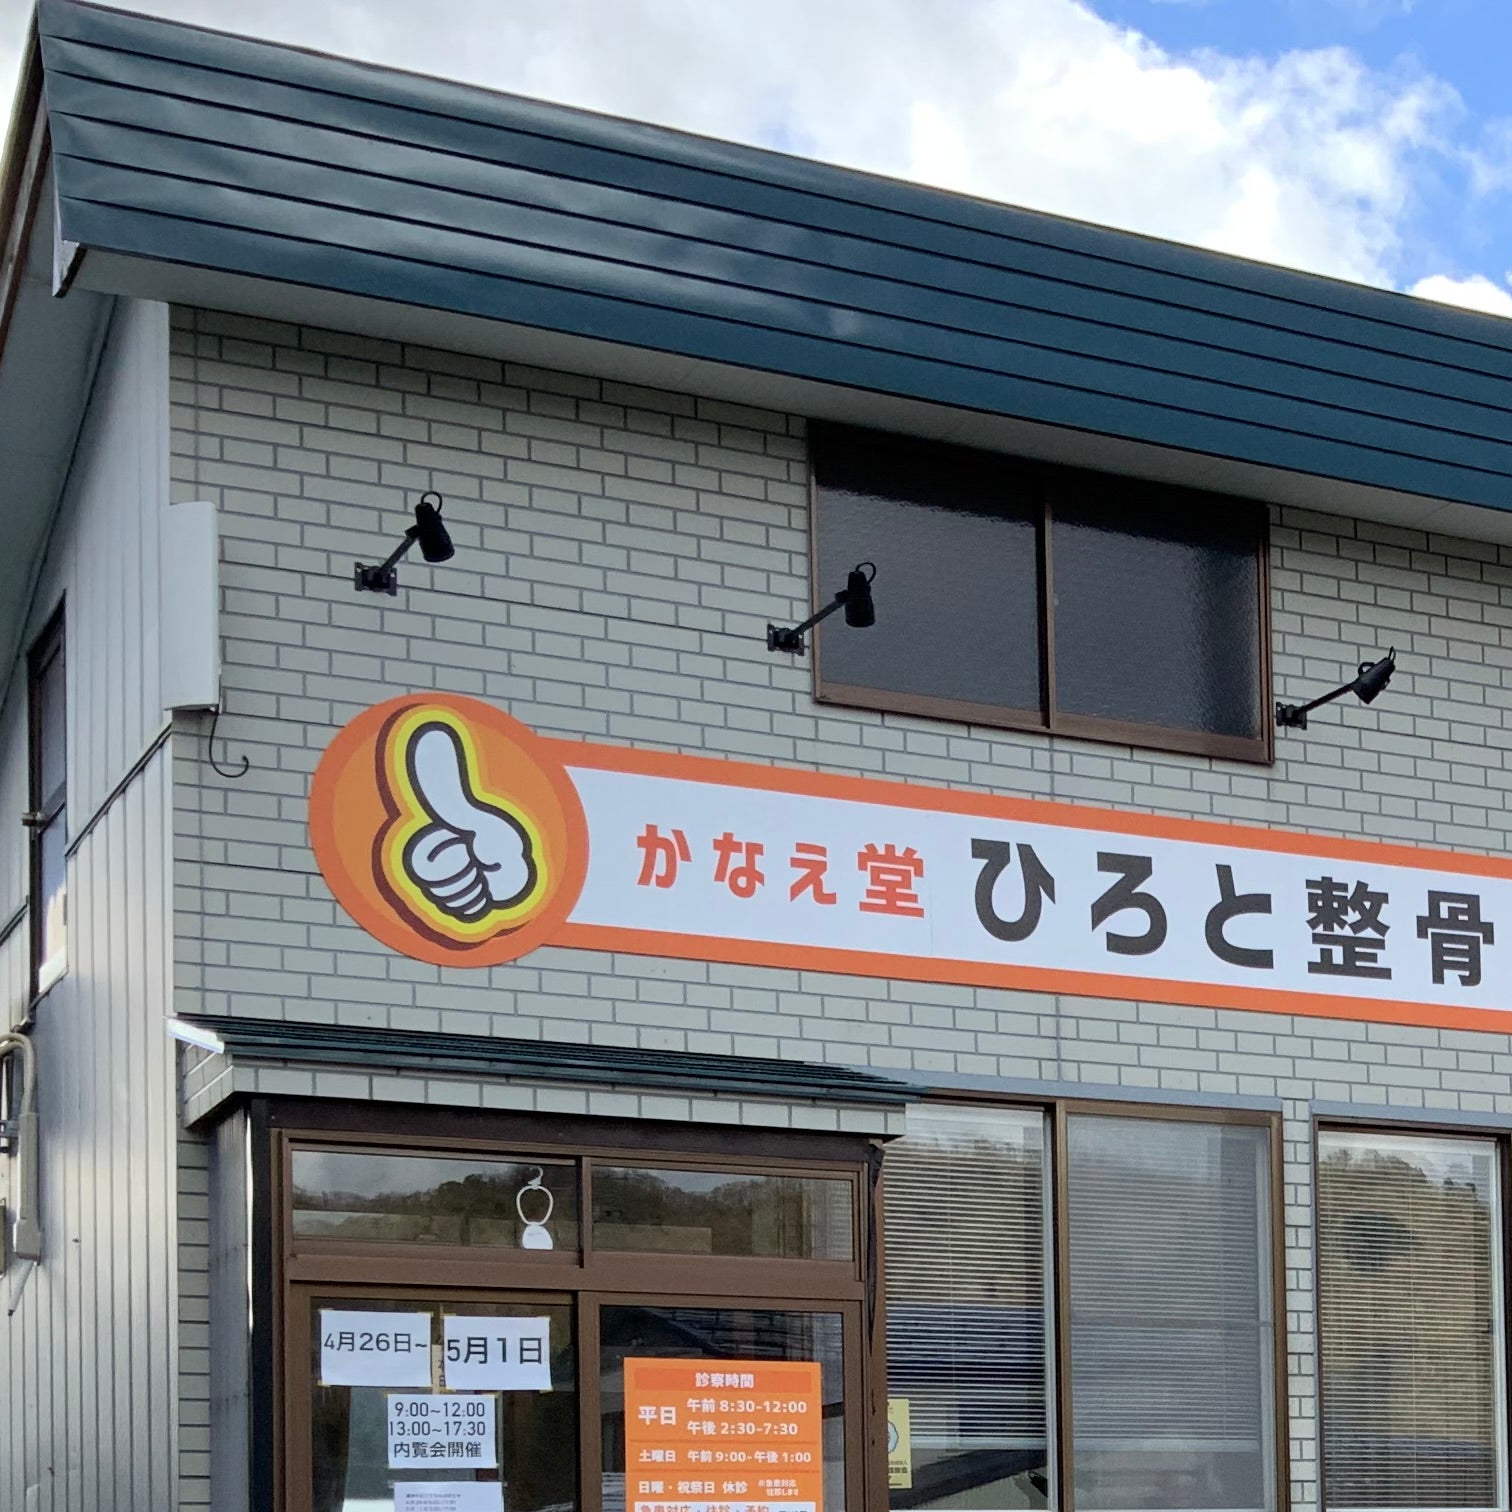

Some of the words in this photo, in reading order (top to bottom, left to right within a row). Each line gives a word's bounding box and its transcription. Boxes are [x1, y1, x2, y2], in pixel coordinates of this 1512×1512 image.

[636, 822, 925, 919] かなえ堂
[446, 1336, 543, 1365] 5月1日
[695, 1372, 755, 1389] 診察時間
[394, 1401, 485, 1418] 9:00~12:00
[686, 1398, 716, 1414] 午前
[719, 1400, 808, 1414] 8:30-12:00
[637, 1405, 677, 1426] 平日
[388, 1420, 486, 1436] 13:00~17:30
[686, 1420, 717, 1436] 午後
[720, 1422, 798, 1436] 2:30-7:30
[393, 1441, 483, 1459] 内覧会開催
[638, 1450, 677, 1463] 土曜日
[687, 1451, 713, 1464] 午前
[783, 1452, 812, 1464] 1:00
